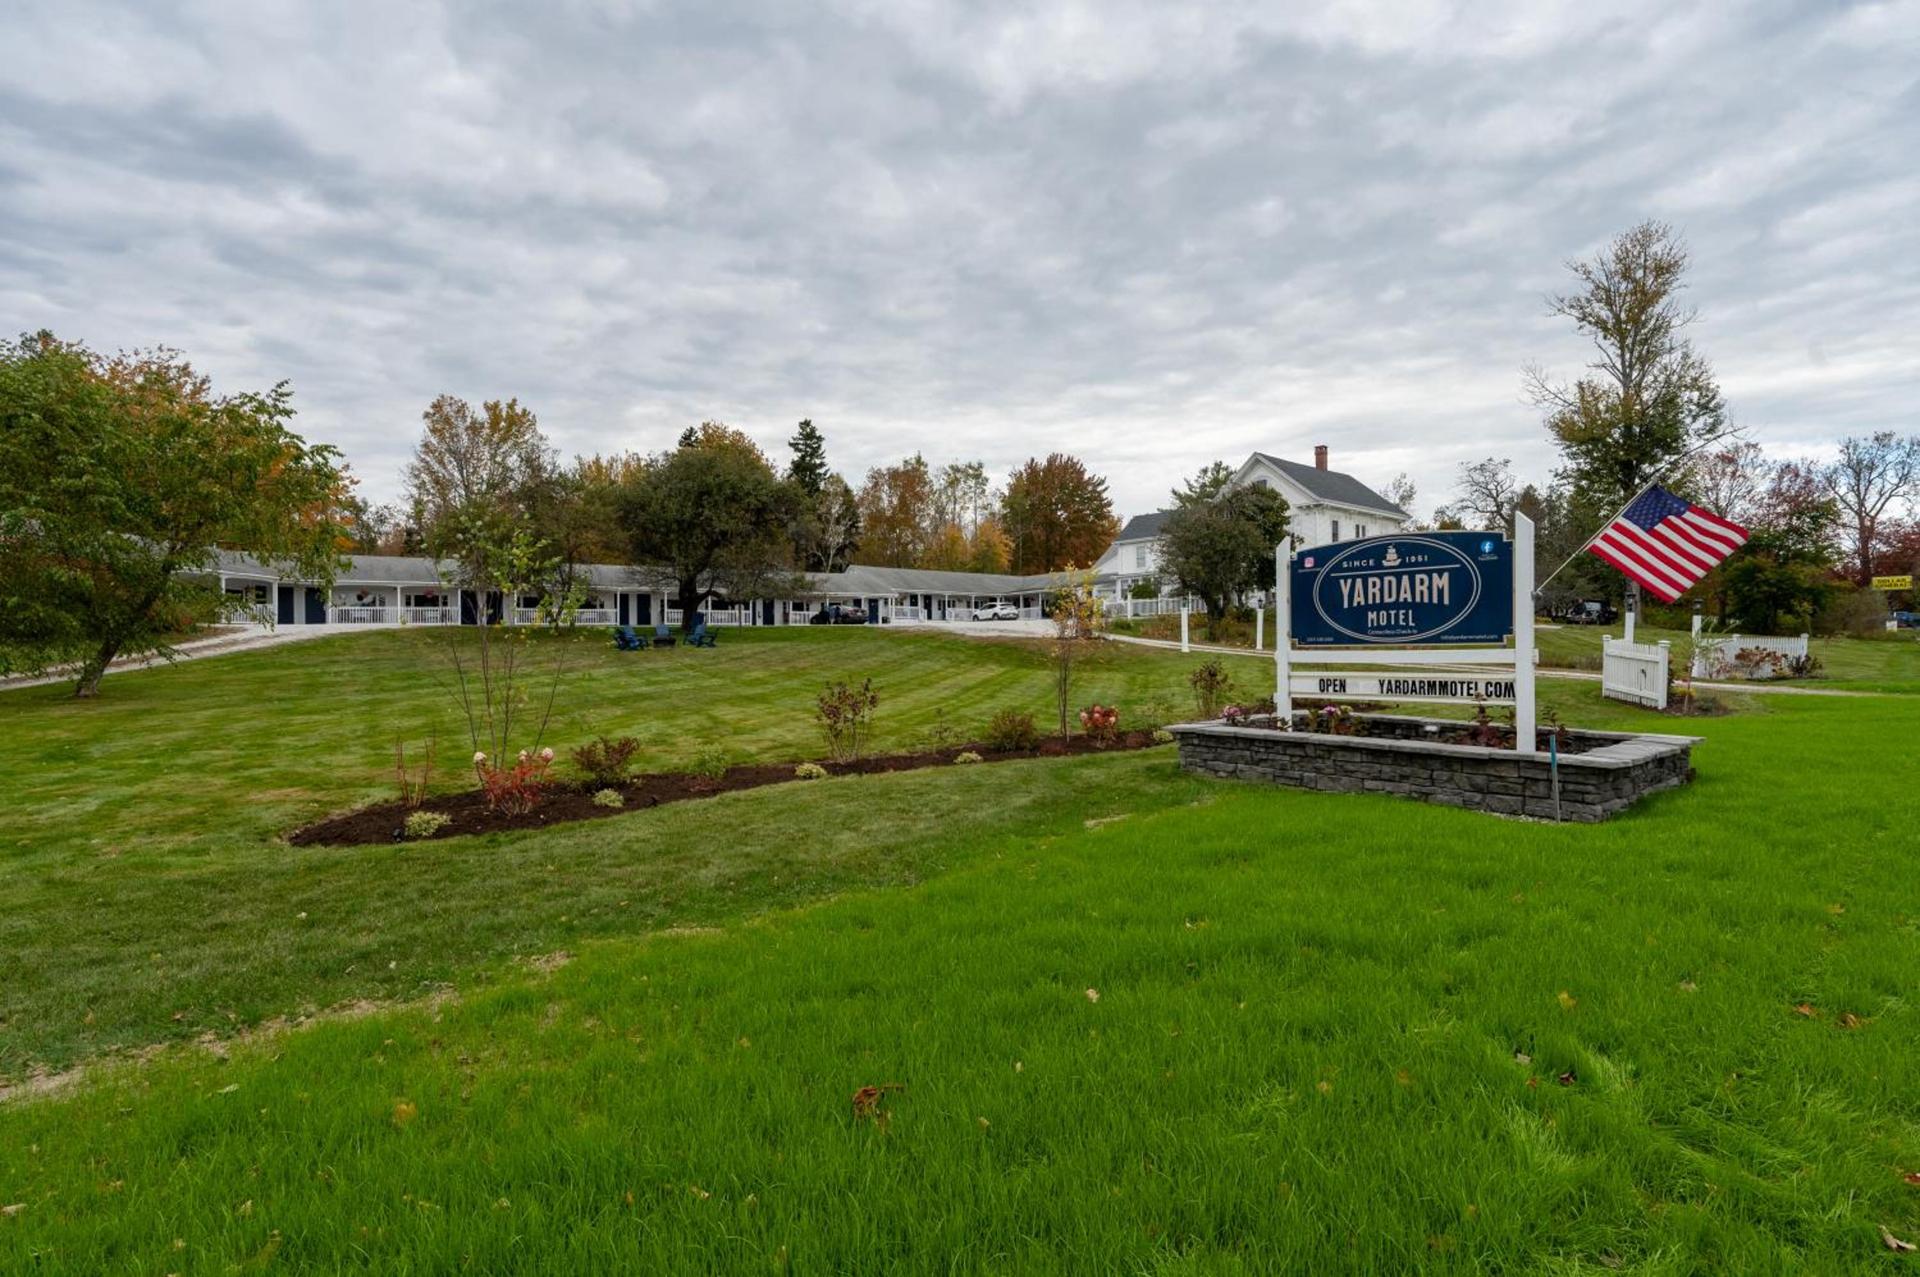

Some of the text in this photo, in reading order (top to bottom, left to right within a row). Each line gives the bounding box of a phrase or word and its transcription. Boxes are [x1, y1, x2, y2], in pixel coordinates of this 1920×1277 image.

[1342, 559, 1375, 568] SINCE
[1339, 572, 1450, 609] YARDARM
[1367, 610, 1415, 627] MOTEL
[1319, 678, 1516, 698] OPEN YARDARMMOTECOM
